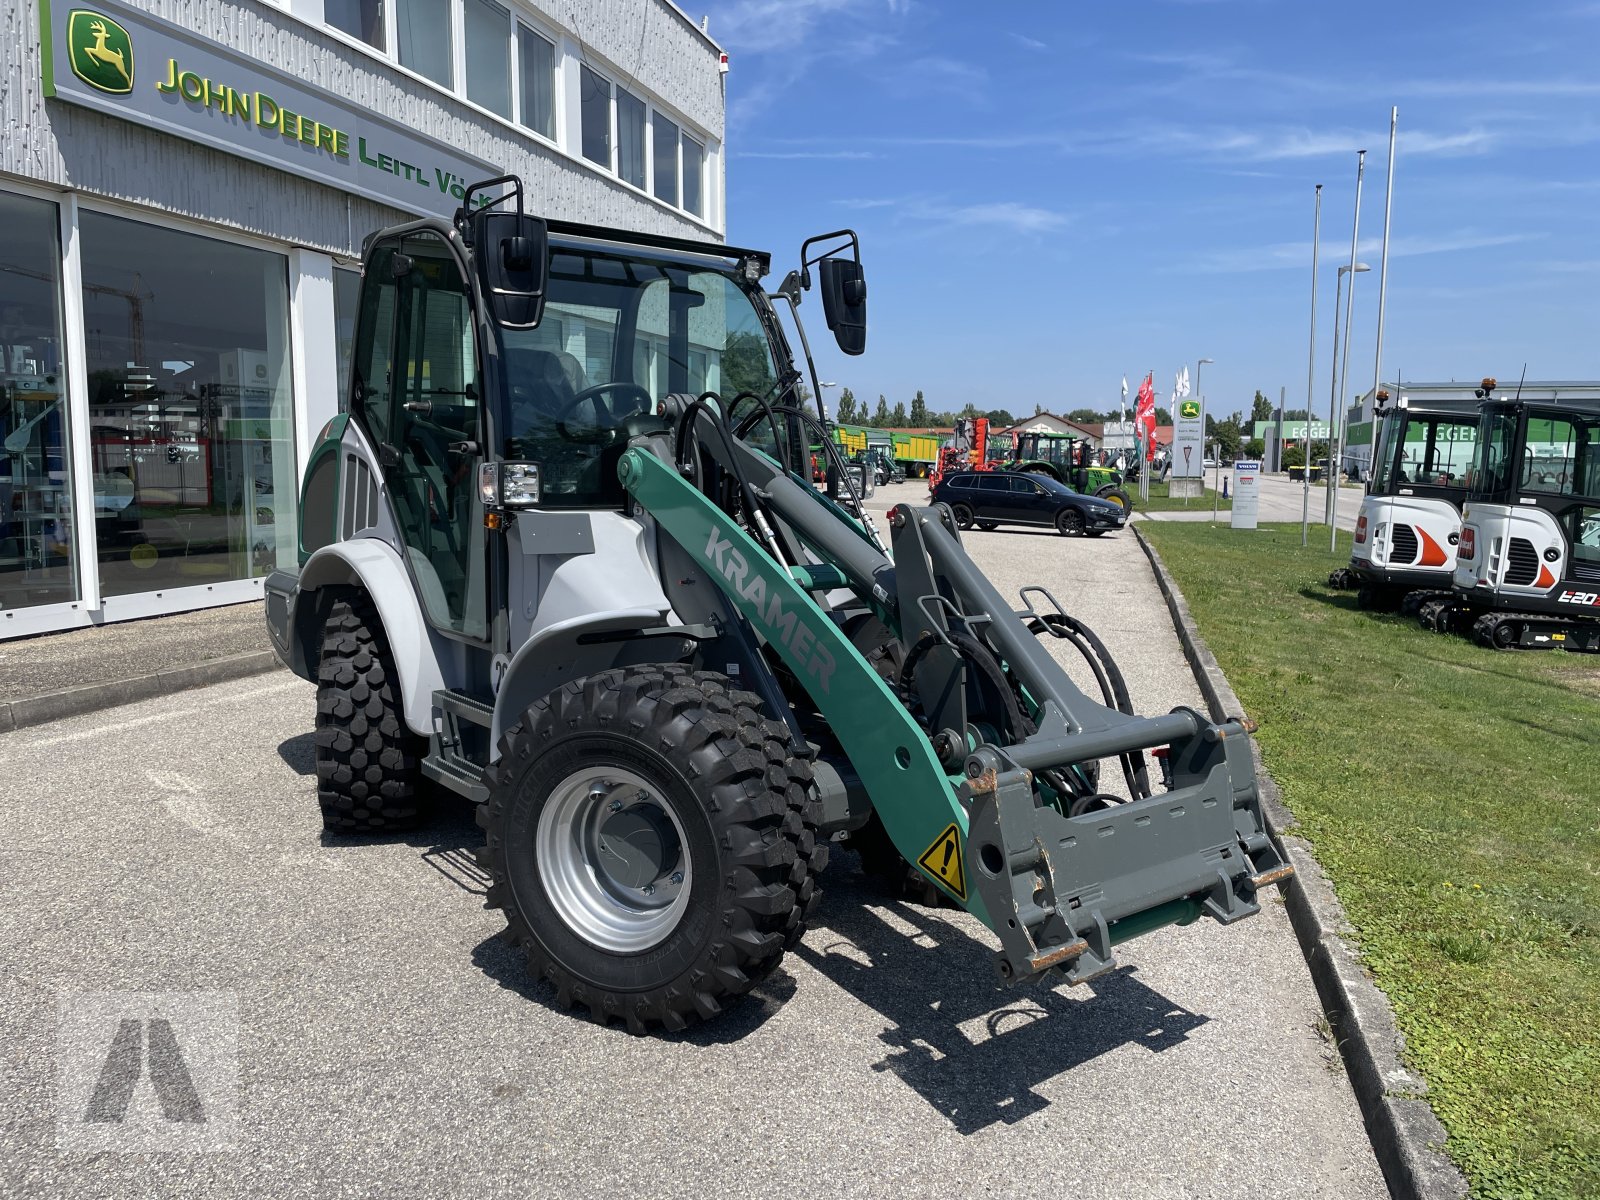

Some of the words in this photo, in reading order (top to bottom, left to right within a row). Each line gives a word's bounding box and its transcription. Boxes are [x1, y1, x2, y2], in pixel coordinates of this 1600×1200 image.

[156, 58, 251, 122] JOHN
[254, 91, 350, 157] DEERE
[358, 136, 430, 187] LEITL
[434, 167, 493, 209] VÖK
[1292, 427, 1331, 439] EGGE
[704, 525, 836, 695] KRAMER
